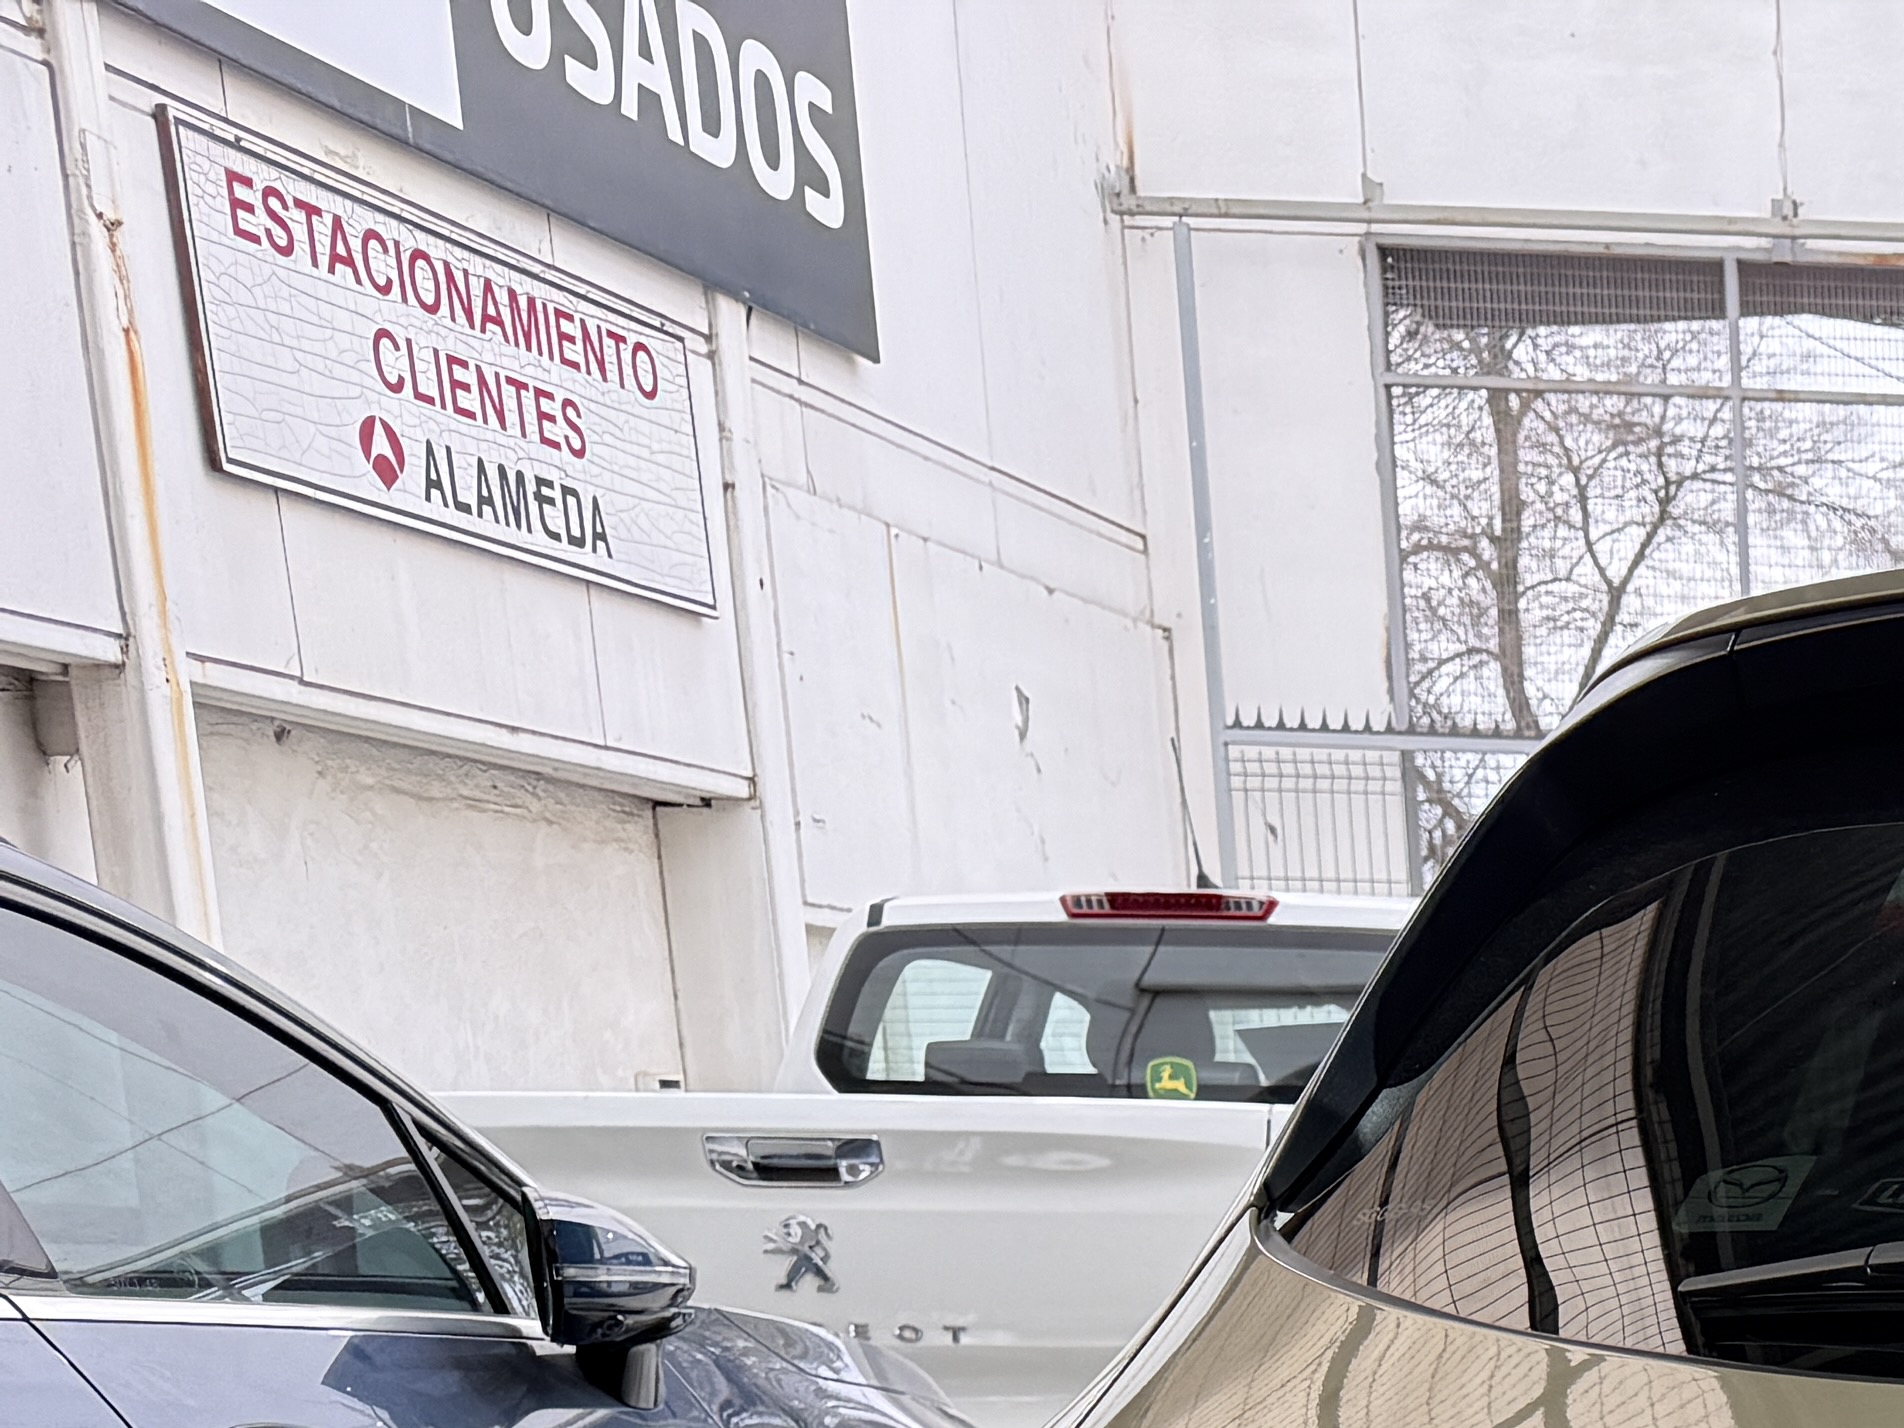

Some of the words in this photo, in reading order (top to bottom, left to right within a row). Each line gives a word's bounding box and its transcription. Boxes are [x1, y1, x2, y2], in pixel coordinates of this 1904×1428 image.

[224, 168, 659, 401] ESTACIONAMIENTO
[372, 327, 587, 460] CLIENTES
[424, 438, 613, 559] ALAMEDA
